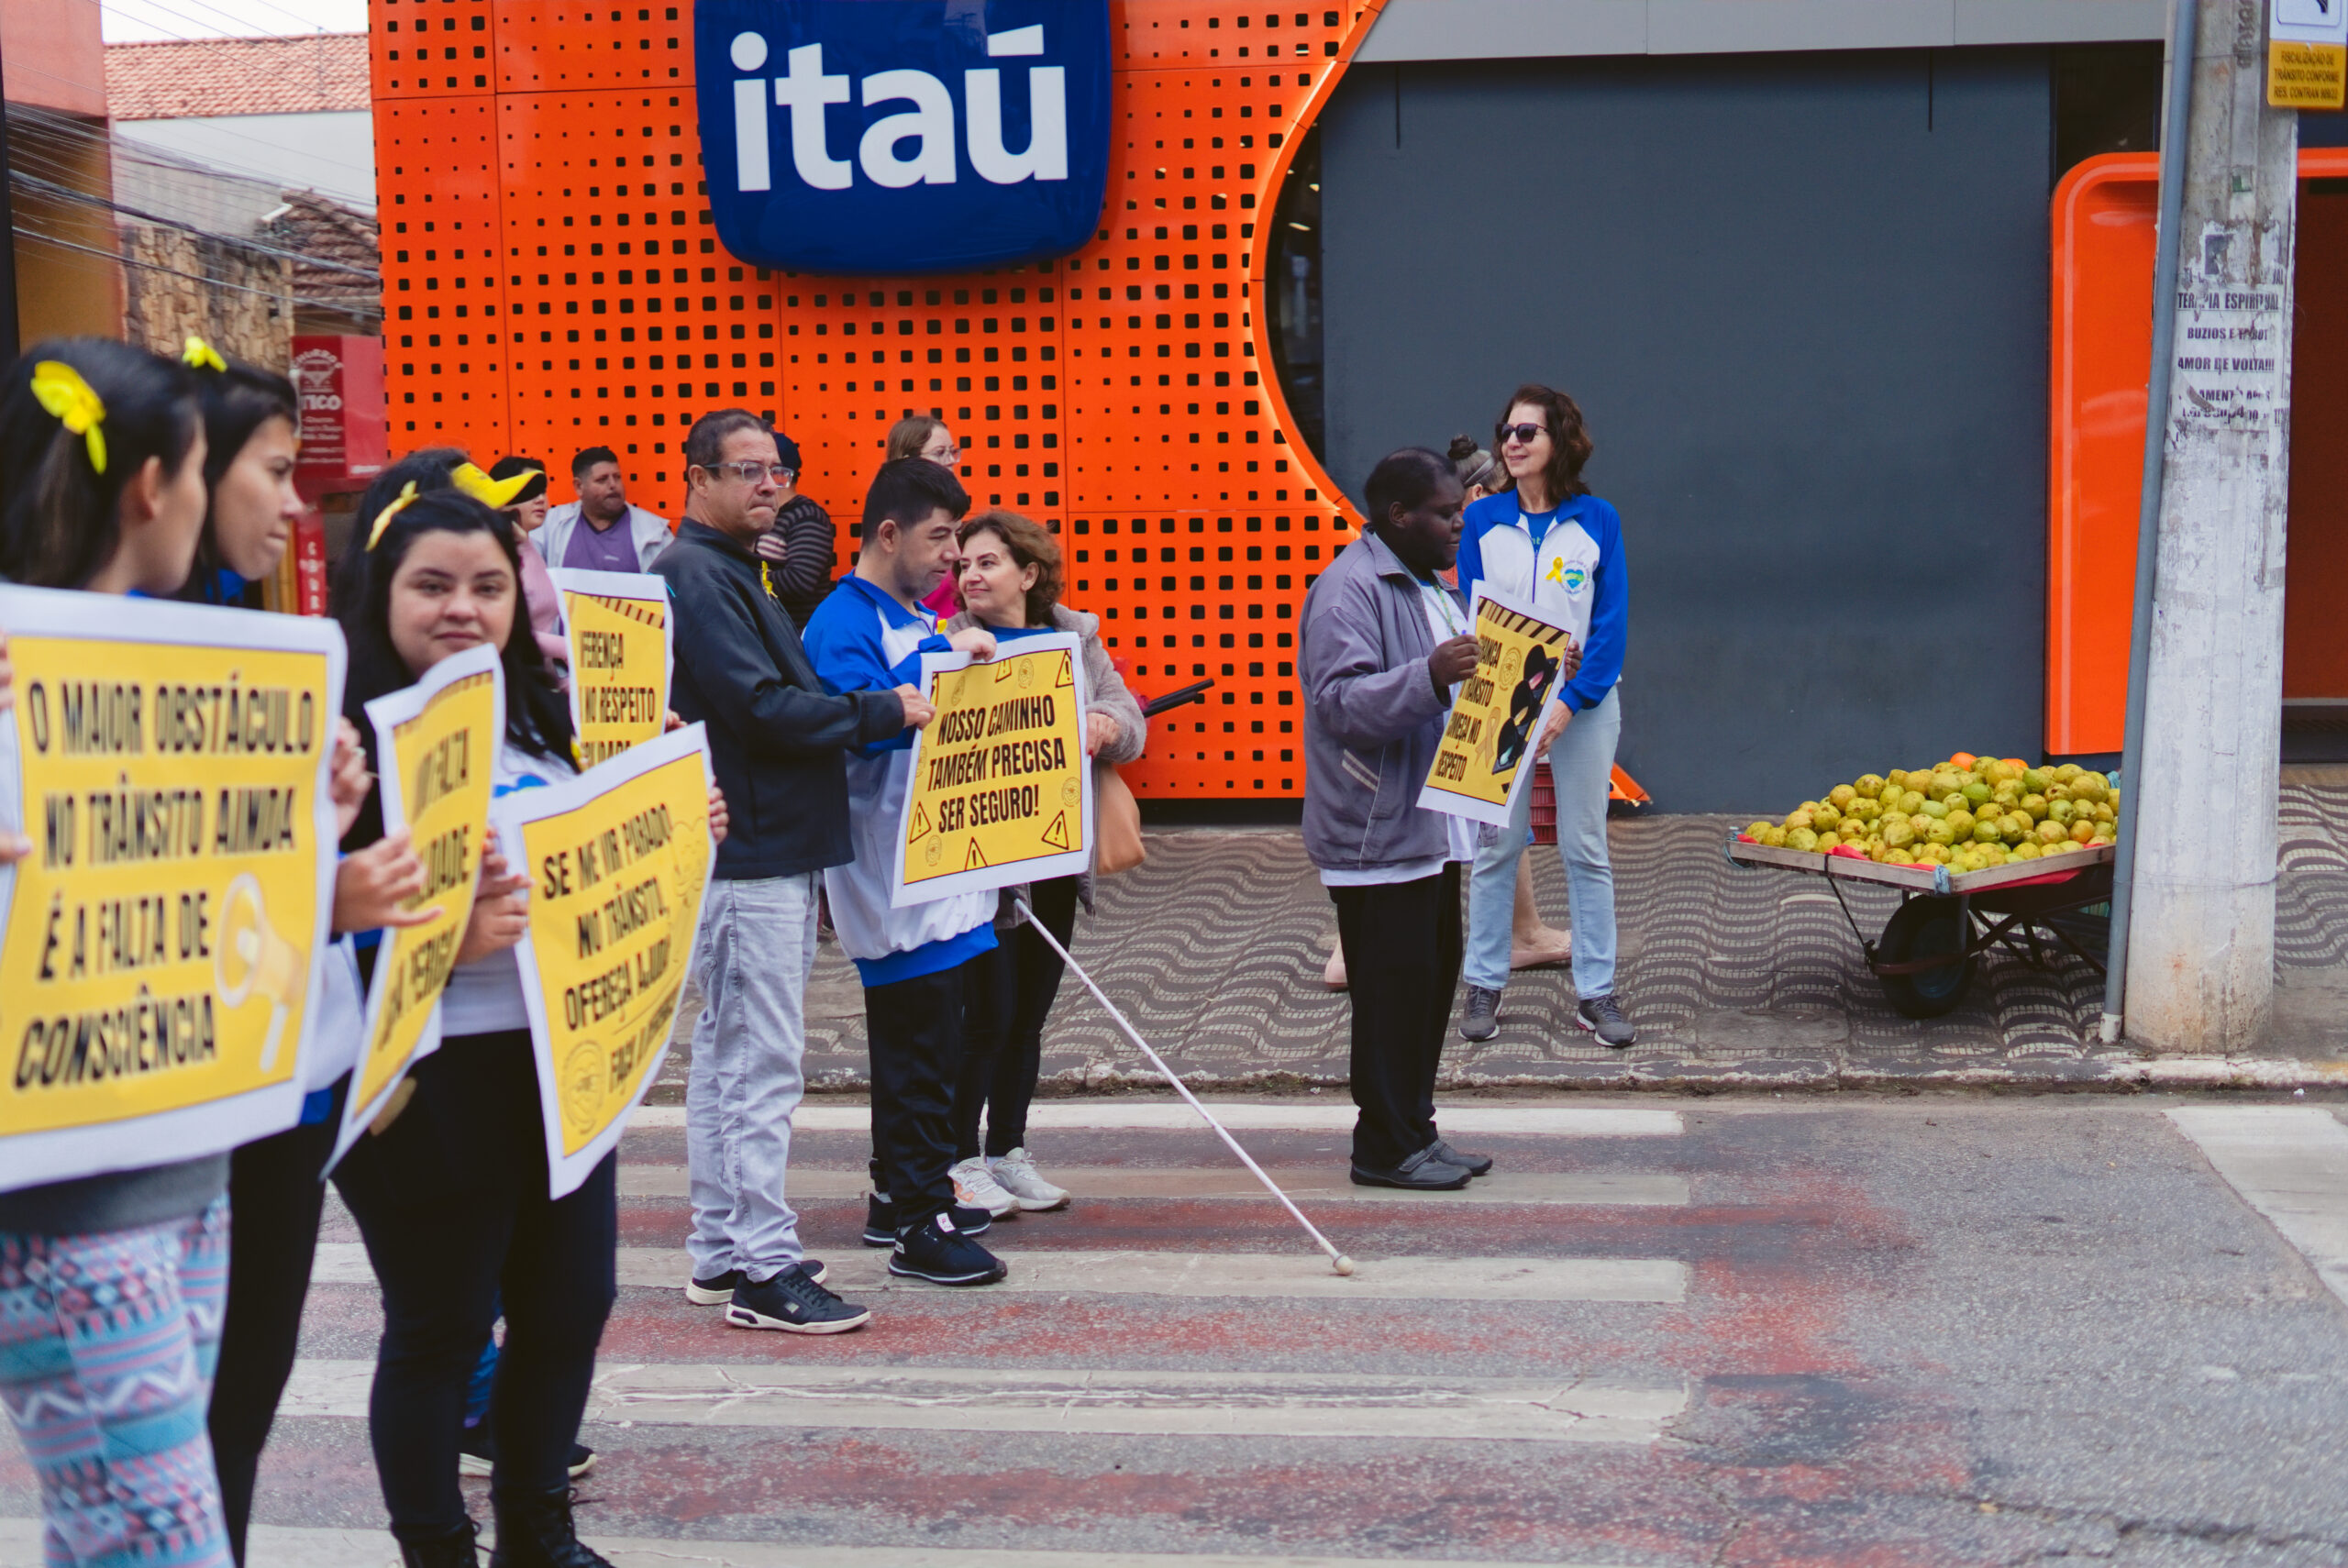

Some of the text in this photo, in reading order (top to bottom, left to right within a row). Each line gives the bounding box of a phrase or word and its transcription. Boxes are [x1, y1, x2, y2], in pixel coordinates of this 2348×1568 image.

[730, 24, 1069, 192] itaú
[29, 668, 316, 755] O MAIOR OBSTÁCULO
[600, 687, 655, 723] RESPEITO
[936, 694, 1056, 746] NOSSO CAMINHO
[1469, 717, 1482, 745] NO
[927, 737, 1067, 792] TAMBÉM PRECISA
[43, 770, 297, 868] NO TRÂNSITO AINDA
[938, 784, 1039, 834] SER SEGURO!
[543, 851, 571, 900] SE
[577, 839, 601, 890] ME
[39, 888, 212, 981] É A FALTA DE
[576, 909, 603, 960] NO
[565, 959, 634, 1032] OFEREÇA
[13, 980, 219, 1089] CONSCIÊNCIA
